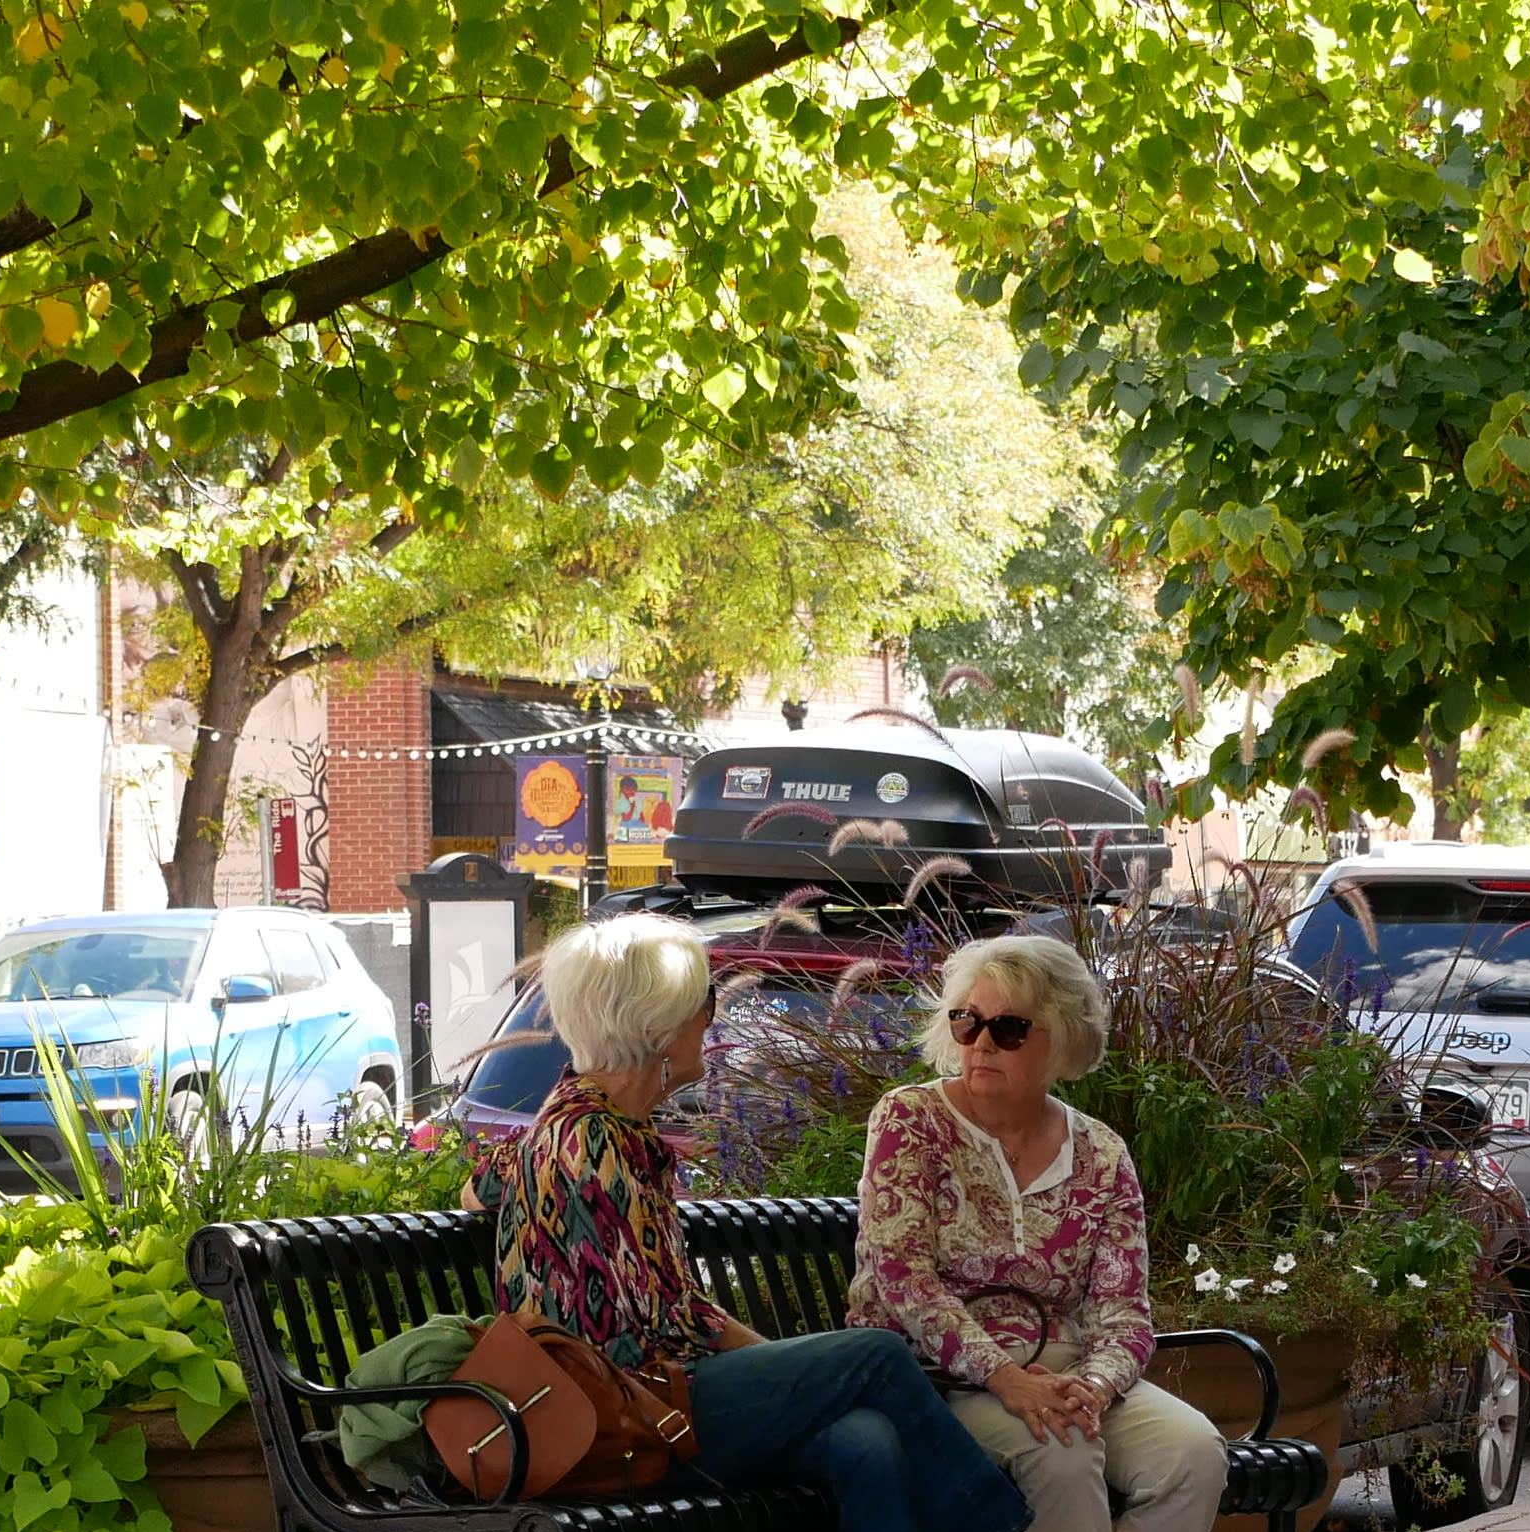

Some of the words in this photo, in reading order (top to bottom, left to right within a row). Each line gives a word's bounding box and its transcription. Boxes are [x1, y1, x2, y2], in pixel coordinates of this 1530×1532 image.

[781, 781, 853, 802] THULE
[271, 800, 281, 828] Ride
[273, 832, 283, 856] The
[1447, 1025, 1511, 1054] Jeep
